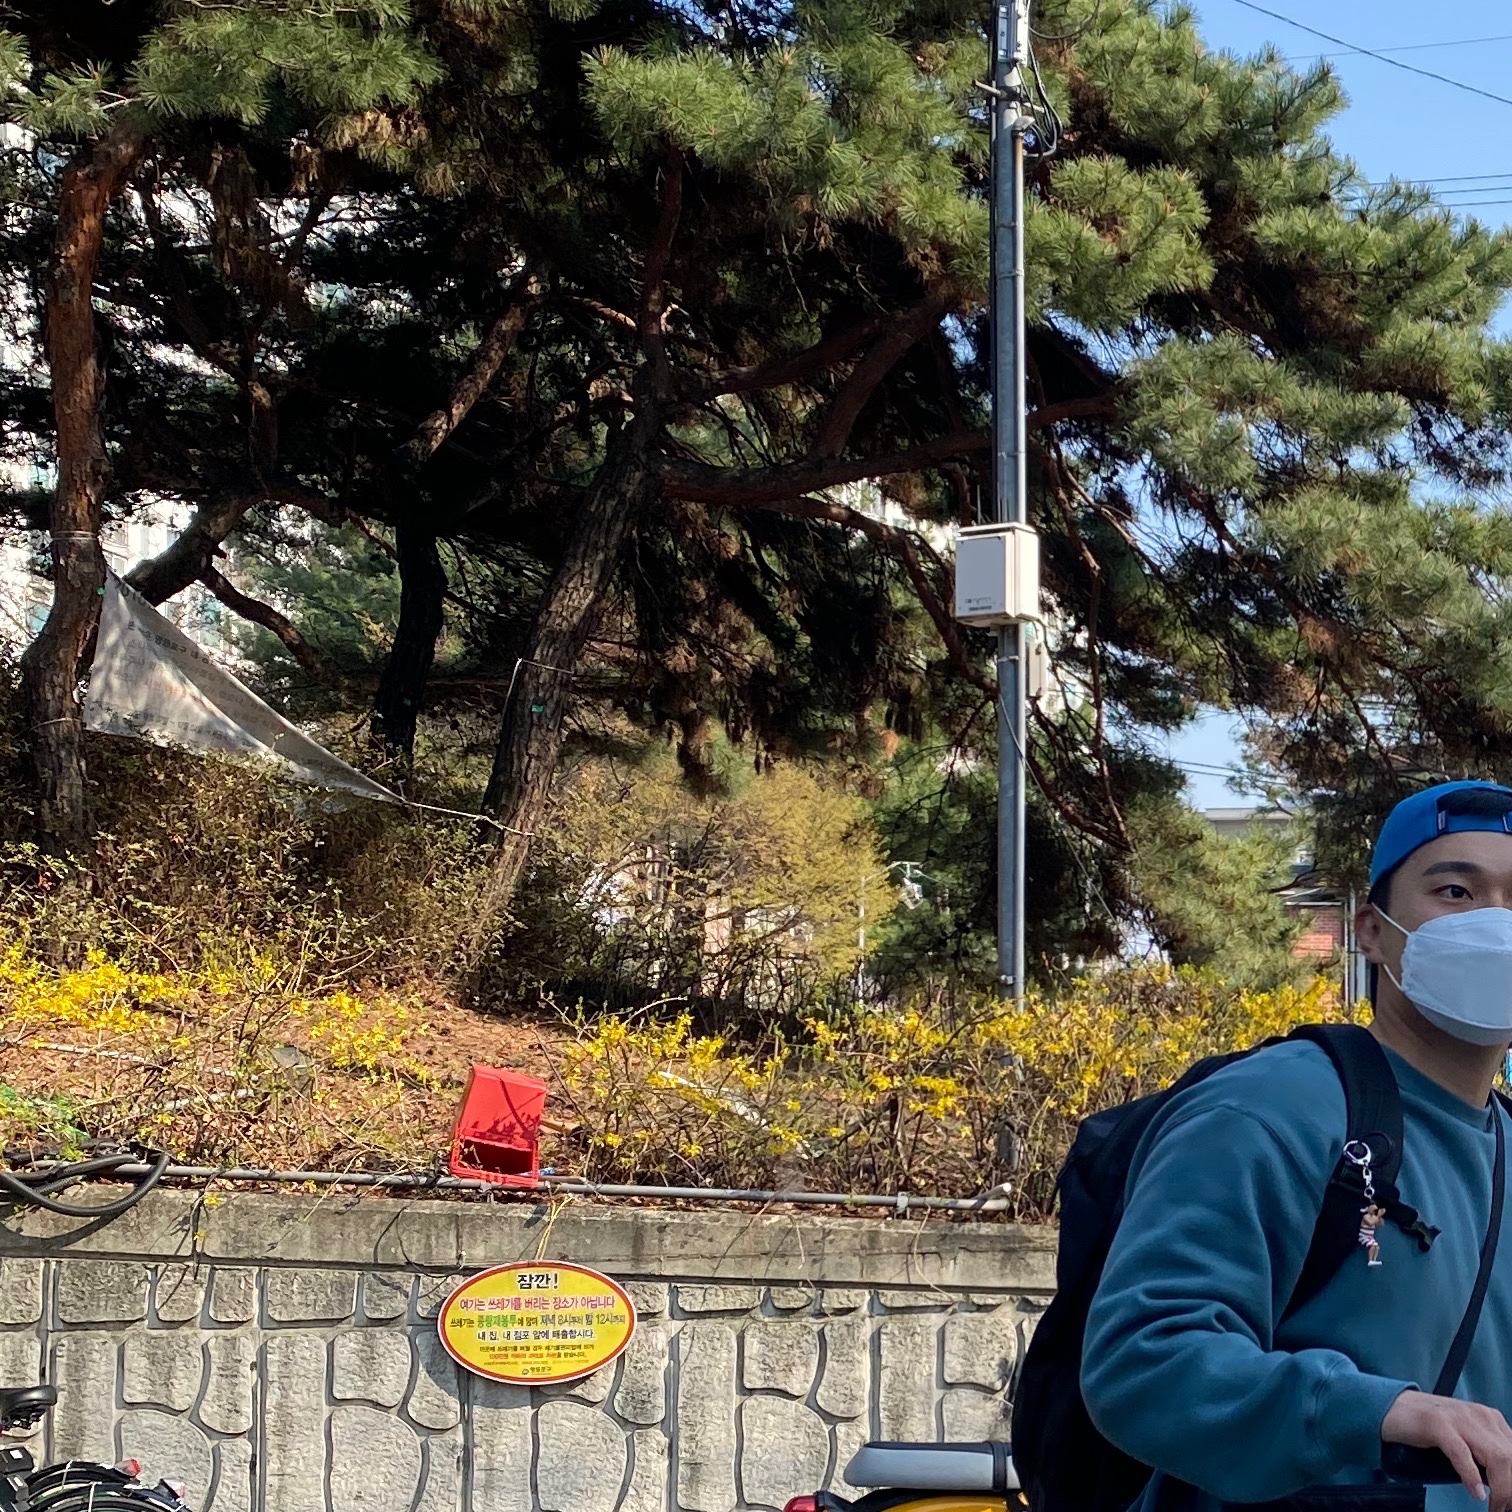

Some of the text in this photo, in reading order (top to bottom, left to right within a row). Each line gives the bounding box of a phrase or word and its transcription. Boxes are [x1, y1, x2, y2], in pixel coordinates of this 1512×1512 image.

[516, 1273, 559, 1290] 잠깐!
[460, 1295, 615, 1312] 여기는 쓰레기를 버리는 장소가 아닙니다
[477, 1331, 486, 1341] 내
[502, 1330, 511, 1341] 내
[513, 1330, 530, 1340] 점포
